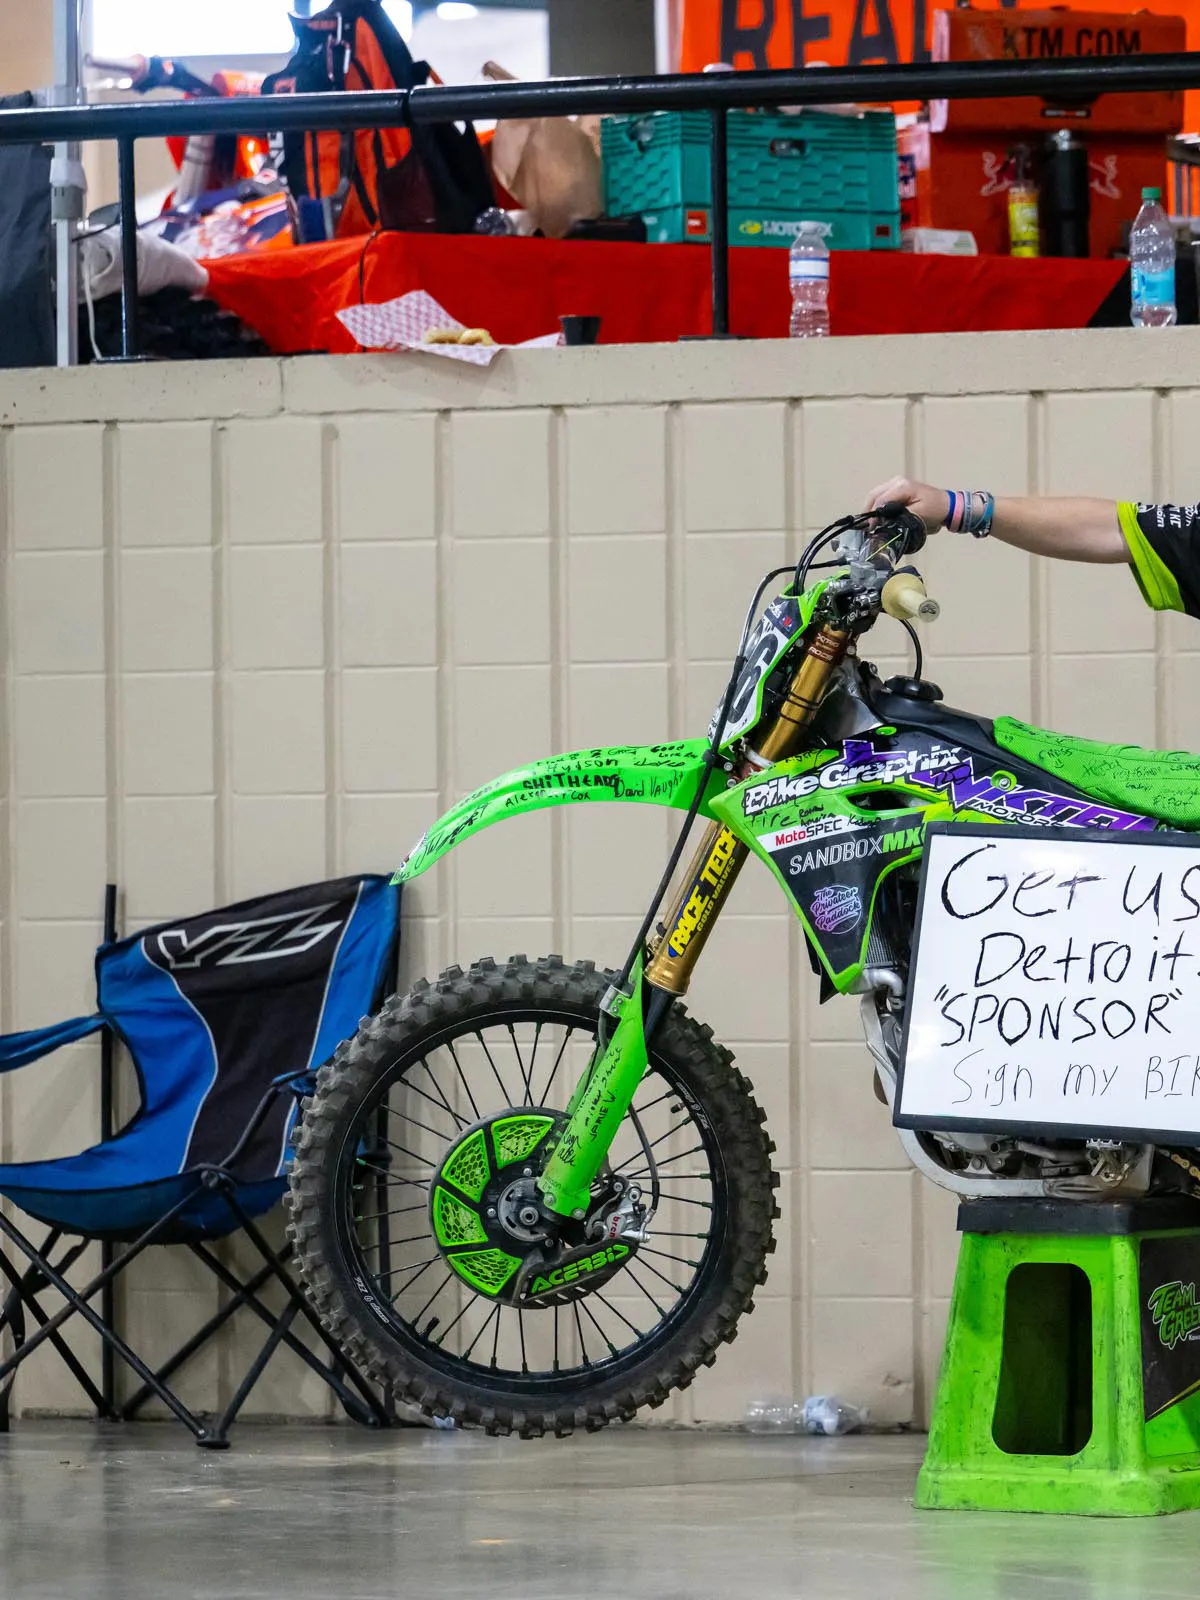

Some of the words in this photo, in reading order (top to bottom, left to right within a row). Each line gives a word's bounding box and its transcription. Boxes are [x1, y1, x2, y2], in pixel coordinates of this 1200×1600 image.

[775, 818, 843, 847] MotoSPEC
[712, 855, 736, 899] VALVES
[815, 887, 834, 901] The
[941, 843, 1107, 920] Get
[668, 884, 711, 957] RACE
[811, 887, 859, 917] Privateer
[815, 900, 862, 931] Paddock
[951, 1048, 1033, 1107] Sign
[1063, 1062, 1119, 1098] my
[531, 1244, 630, 1294] ACERBIS
[1149, 1281, 1196, 1323] TEAM
